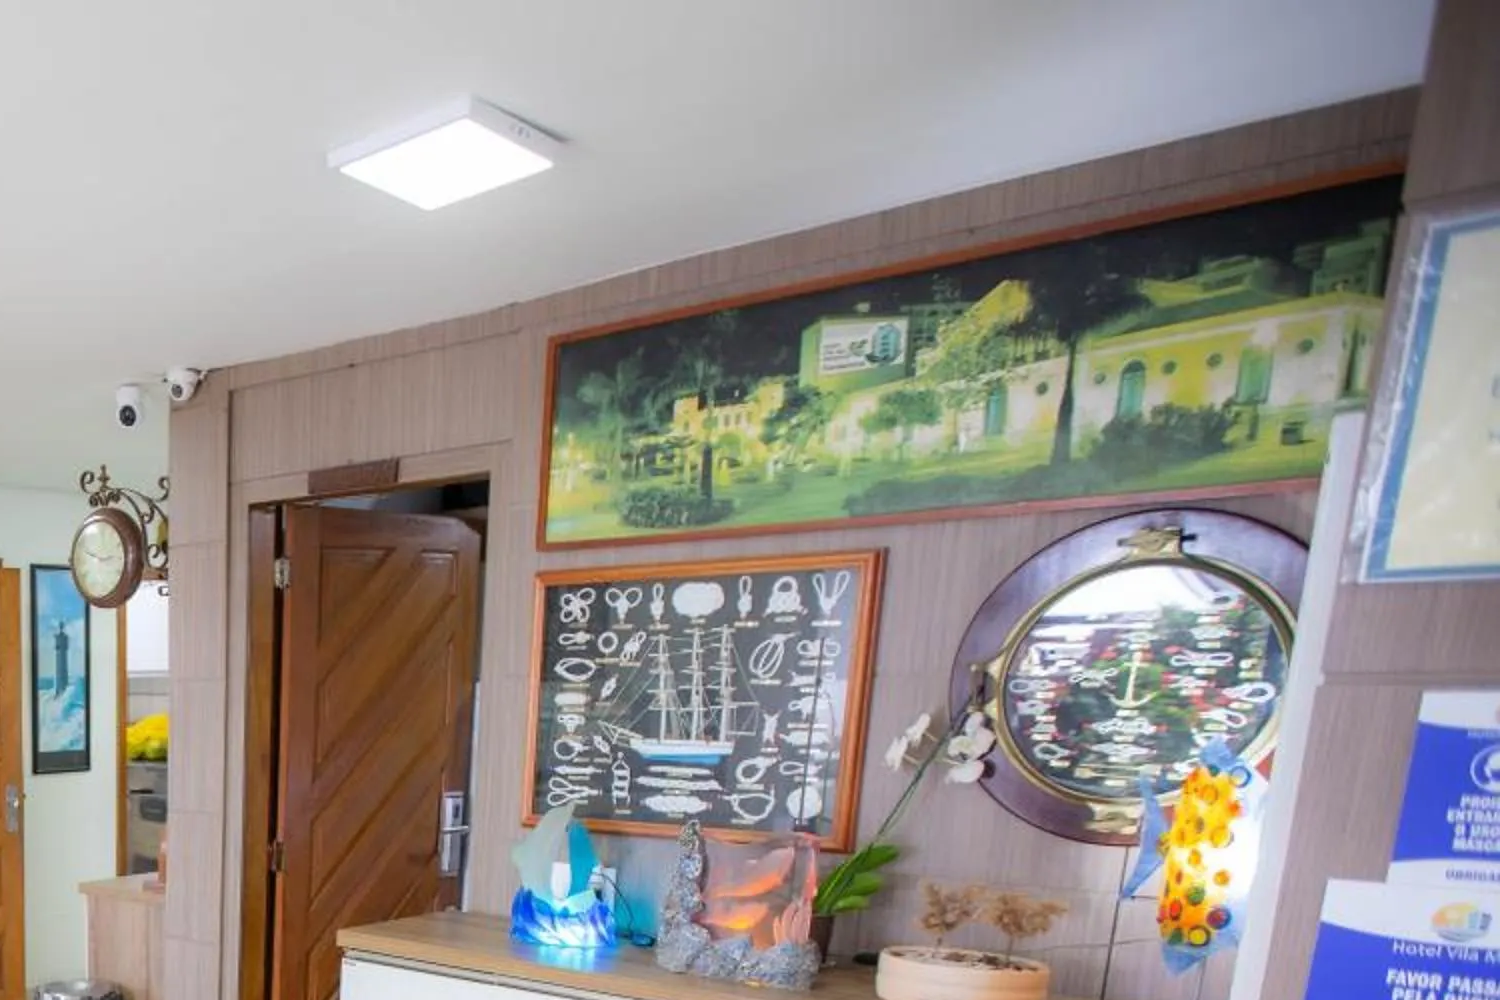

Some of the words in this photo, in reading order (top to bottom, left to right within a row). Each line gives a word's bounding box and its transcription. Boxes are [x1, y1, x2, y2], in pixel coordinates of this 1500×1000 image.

[1392, 938, 1441, 959] Hotel
[1448, 944, 1479, 963] Vila
[1386, 967, 1443, 991] FAVOR
